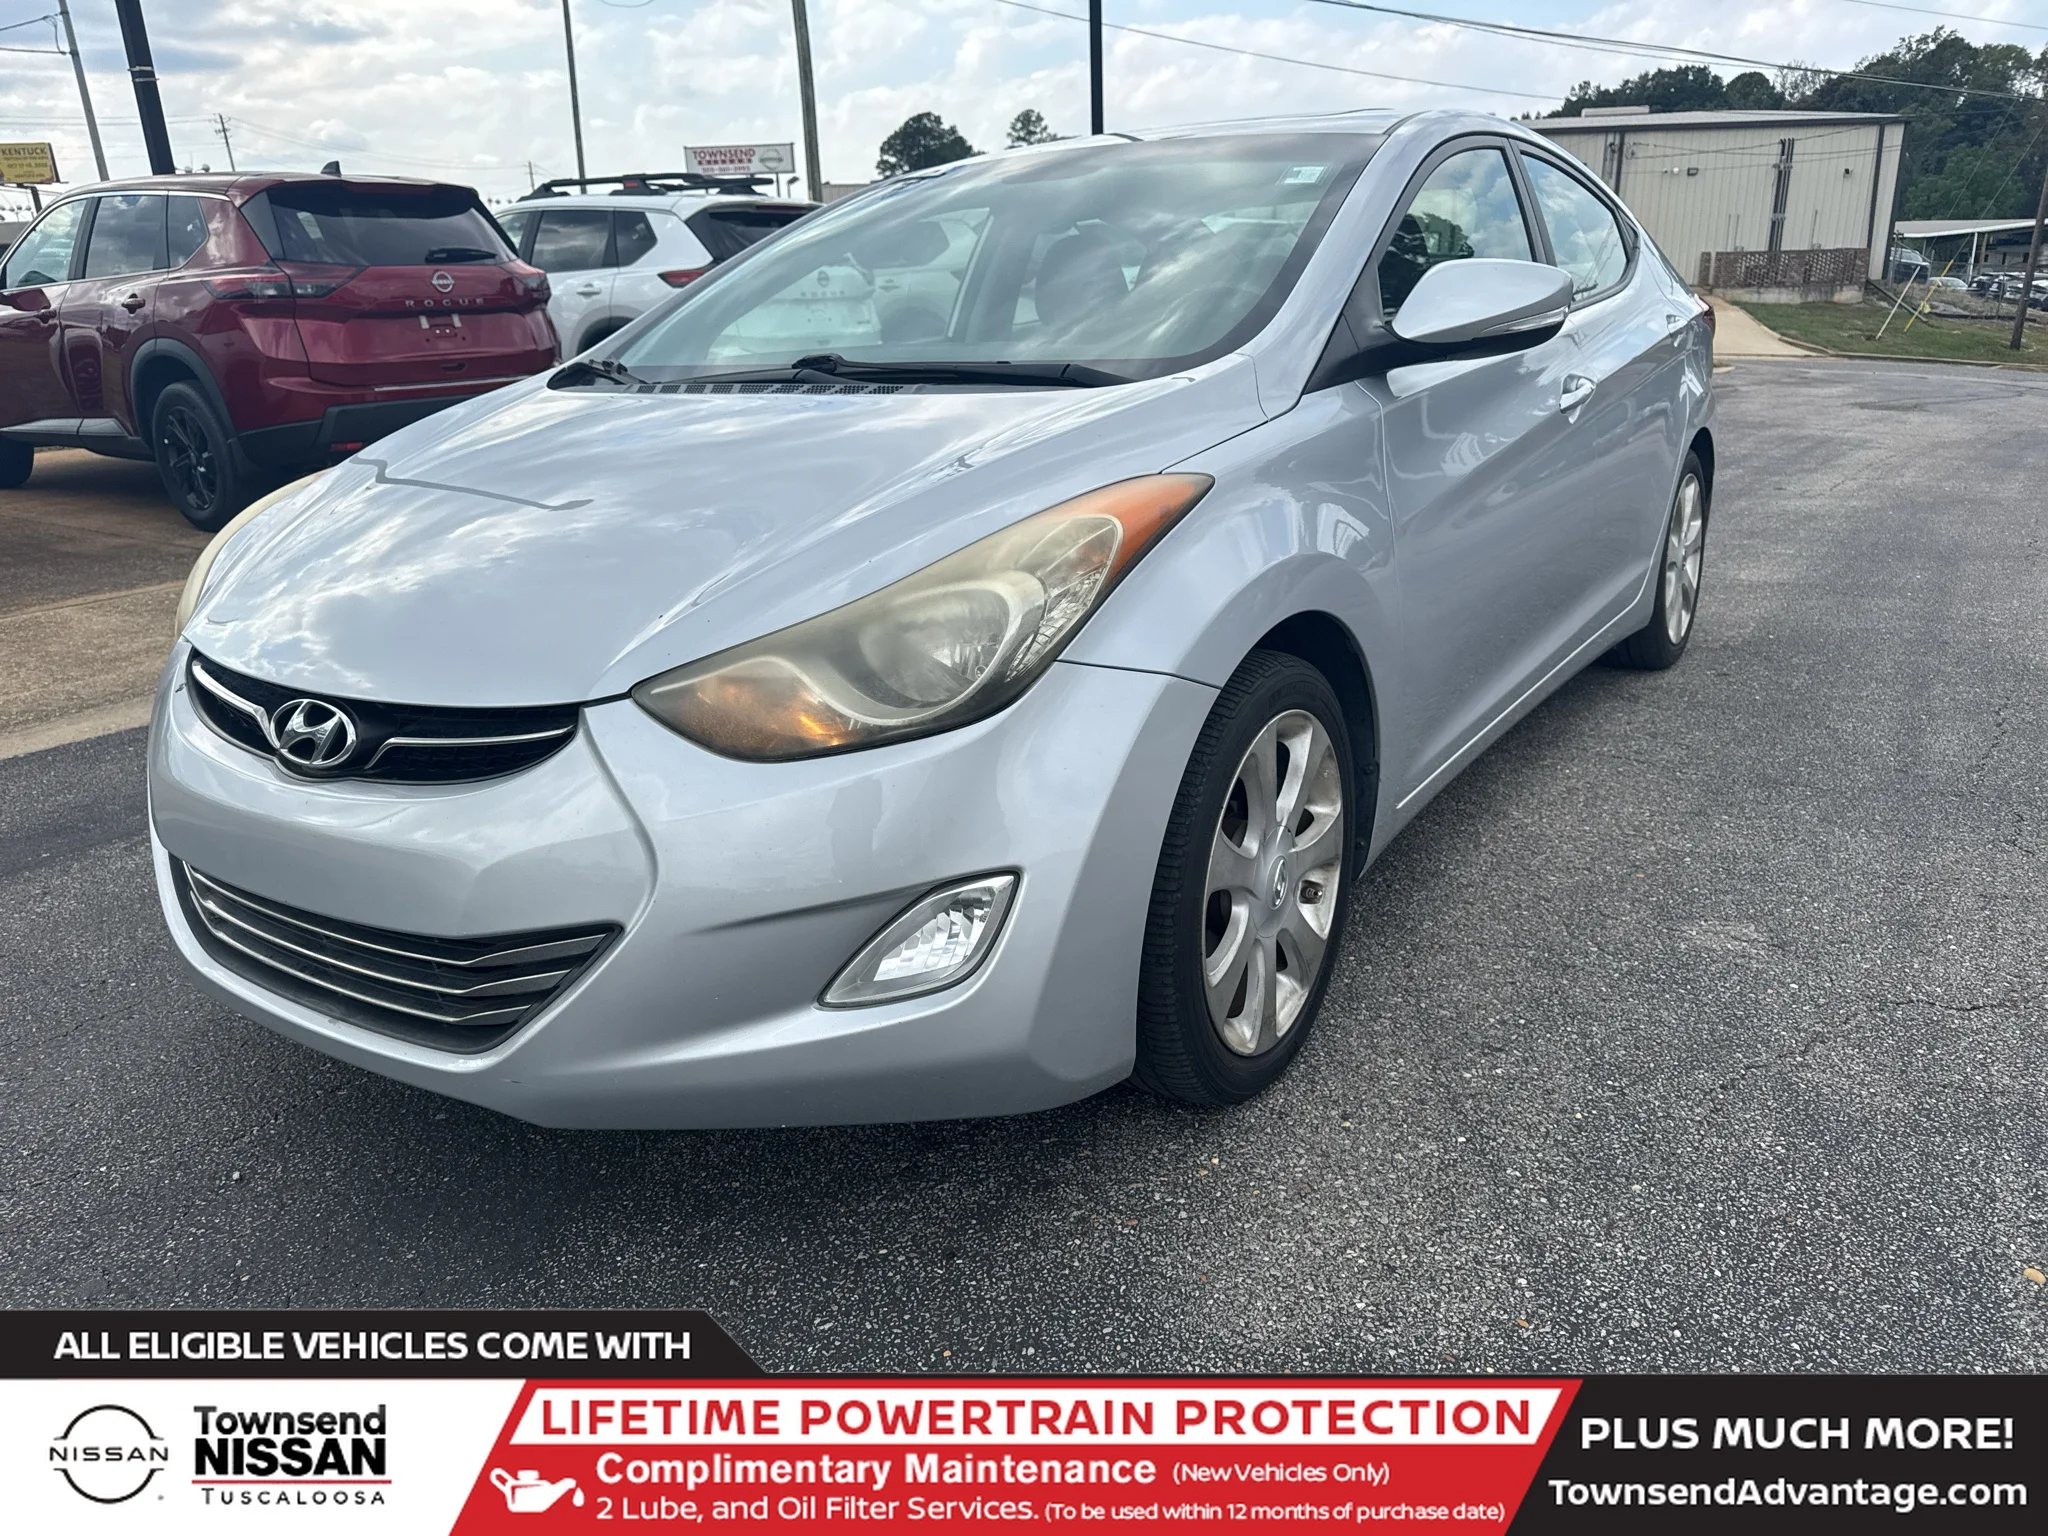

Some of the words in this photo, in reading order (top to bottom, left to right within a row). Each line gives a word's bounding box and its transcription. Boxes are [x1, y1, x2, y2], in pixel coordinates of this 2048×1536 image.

[1, 147, 48, 156] KENTUCK
[692, 148, 756, 160] TOWNSEND
[405, 297, 485, 308] ROGUE
